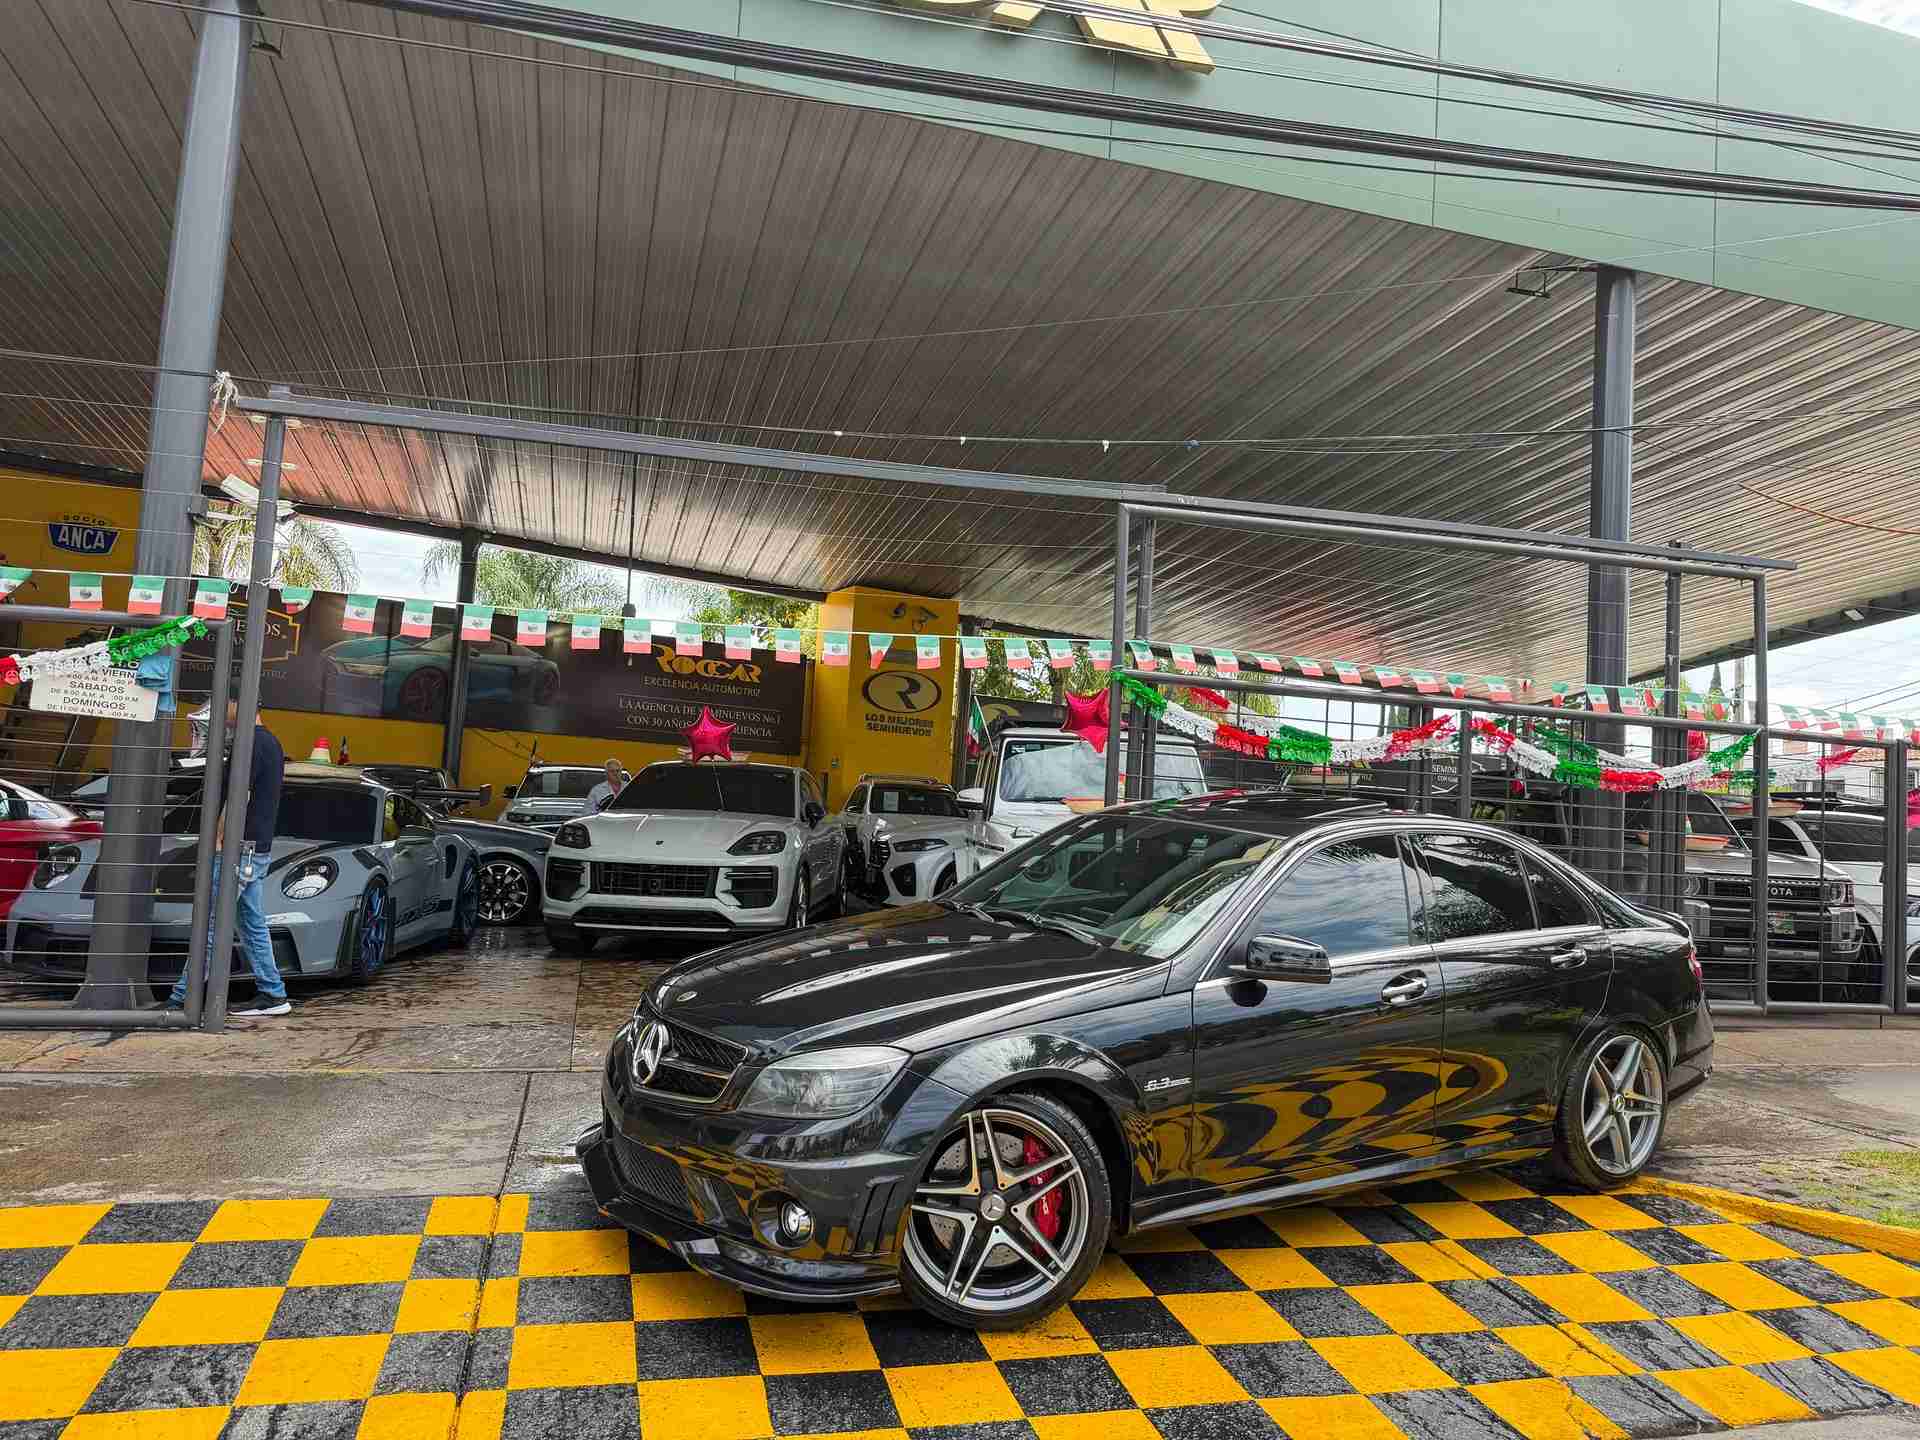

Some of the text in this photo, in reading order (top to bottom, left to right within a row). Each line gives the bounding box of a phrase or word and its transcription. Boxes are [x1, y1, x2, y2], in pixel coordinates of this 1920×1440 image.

[58, 525, 106, 550] ANCA
[652, 643, 762, 684] ROCCAR
[103, 668, 136, 679] VIERN
[644, 675, 698, 690] EXCELENCIA
[63, 697, 126, 710] DOMINGOS
[618, 696, 632, 710] LA
[634, 700, 680, 714] AGENCIA
[682, 704, 697, 716] DE
[627, 715, 648, 727] CON
[651, 717, 663, 728] 30
[865, 713, 934, 728] LOS MEJORES
[865, 722, 932, 737] SEMINUEVOS
